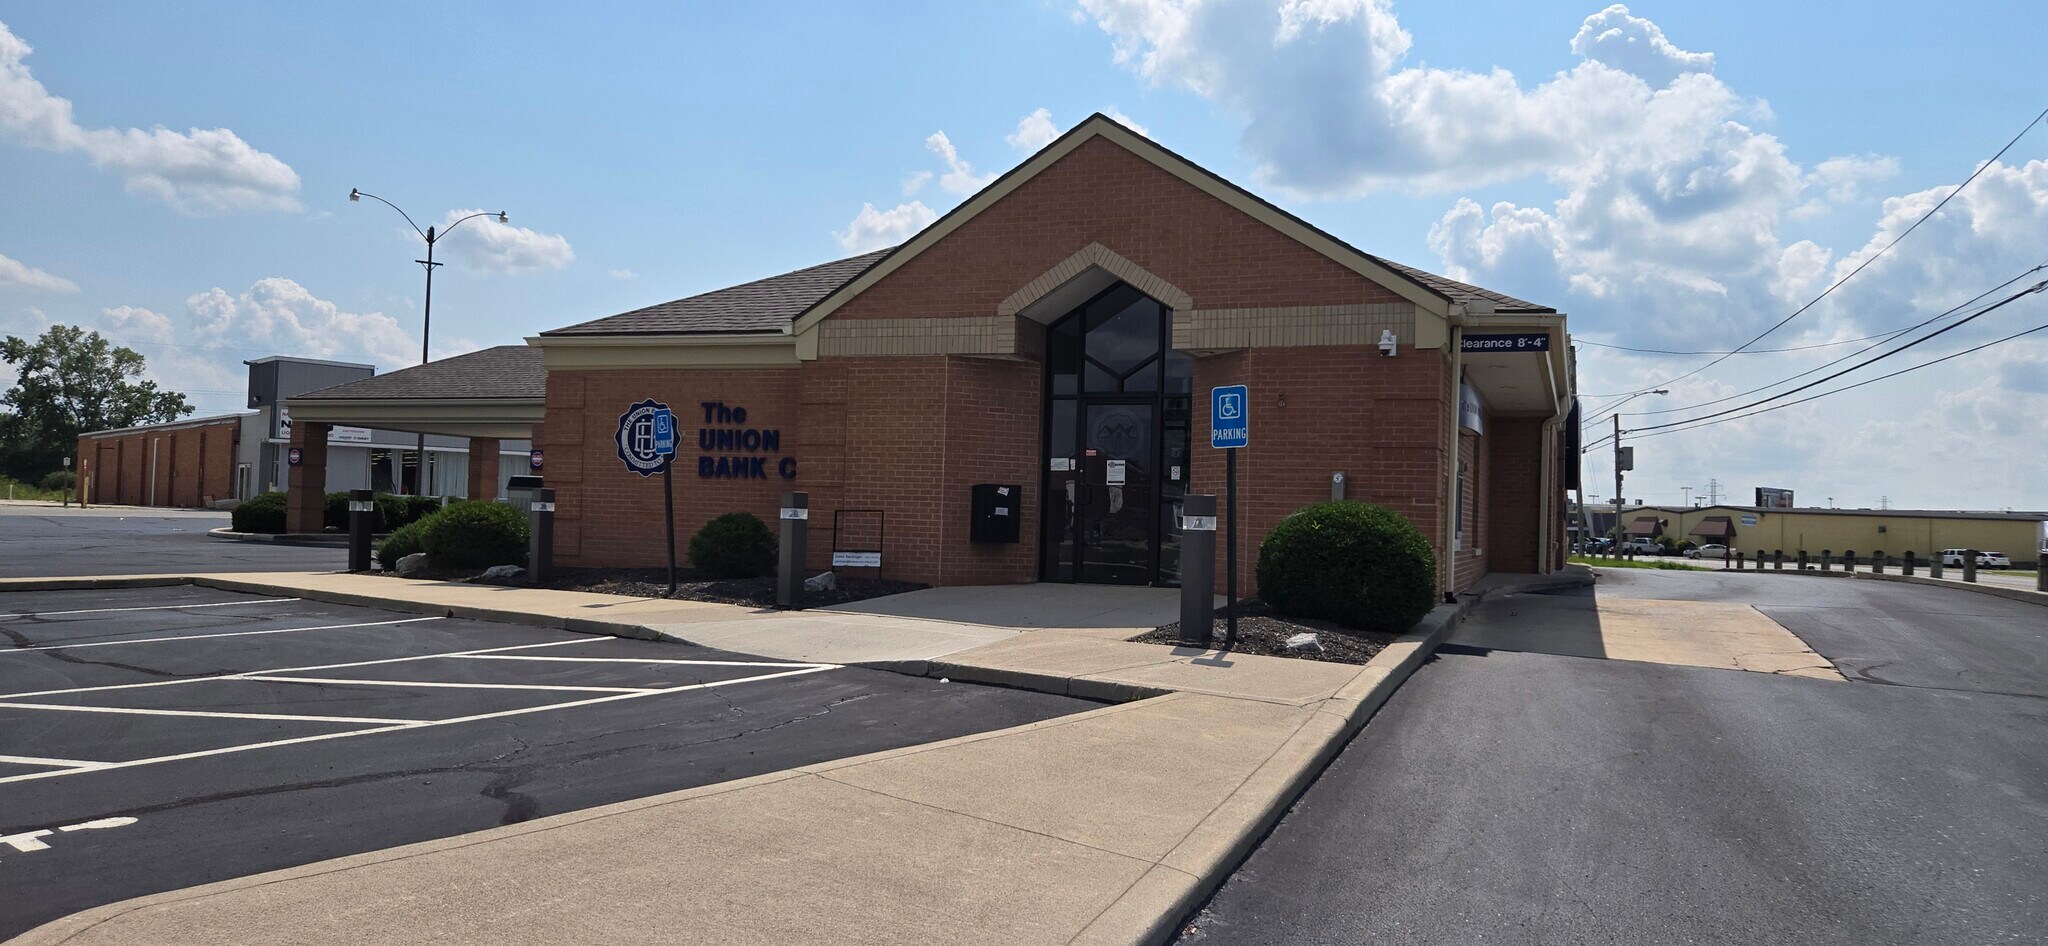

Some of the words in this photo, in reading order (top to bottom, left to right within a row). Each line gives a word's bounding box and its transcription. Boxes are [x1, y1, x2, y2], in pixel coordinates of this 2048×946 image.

[632, 408, 650, 418] UNION
[701, 402, 746, 423] The
[700, 429, 779, 451] UNION
[1213, 427, 1247, 441] PARKING
[699, 456, 766, 479] BANK
